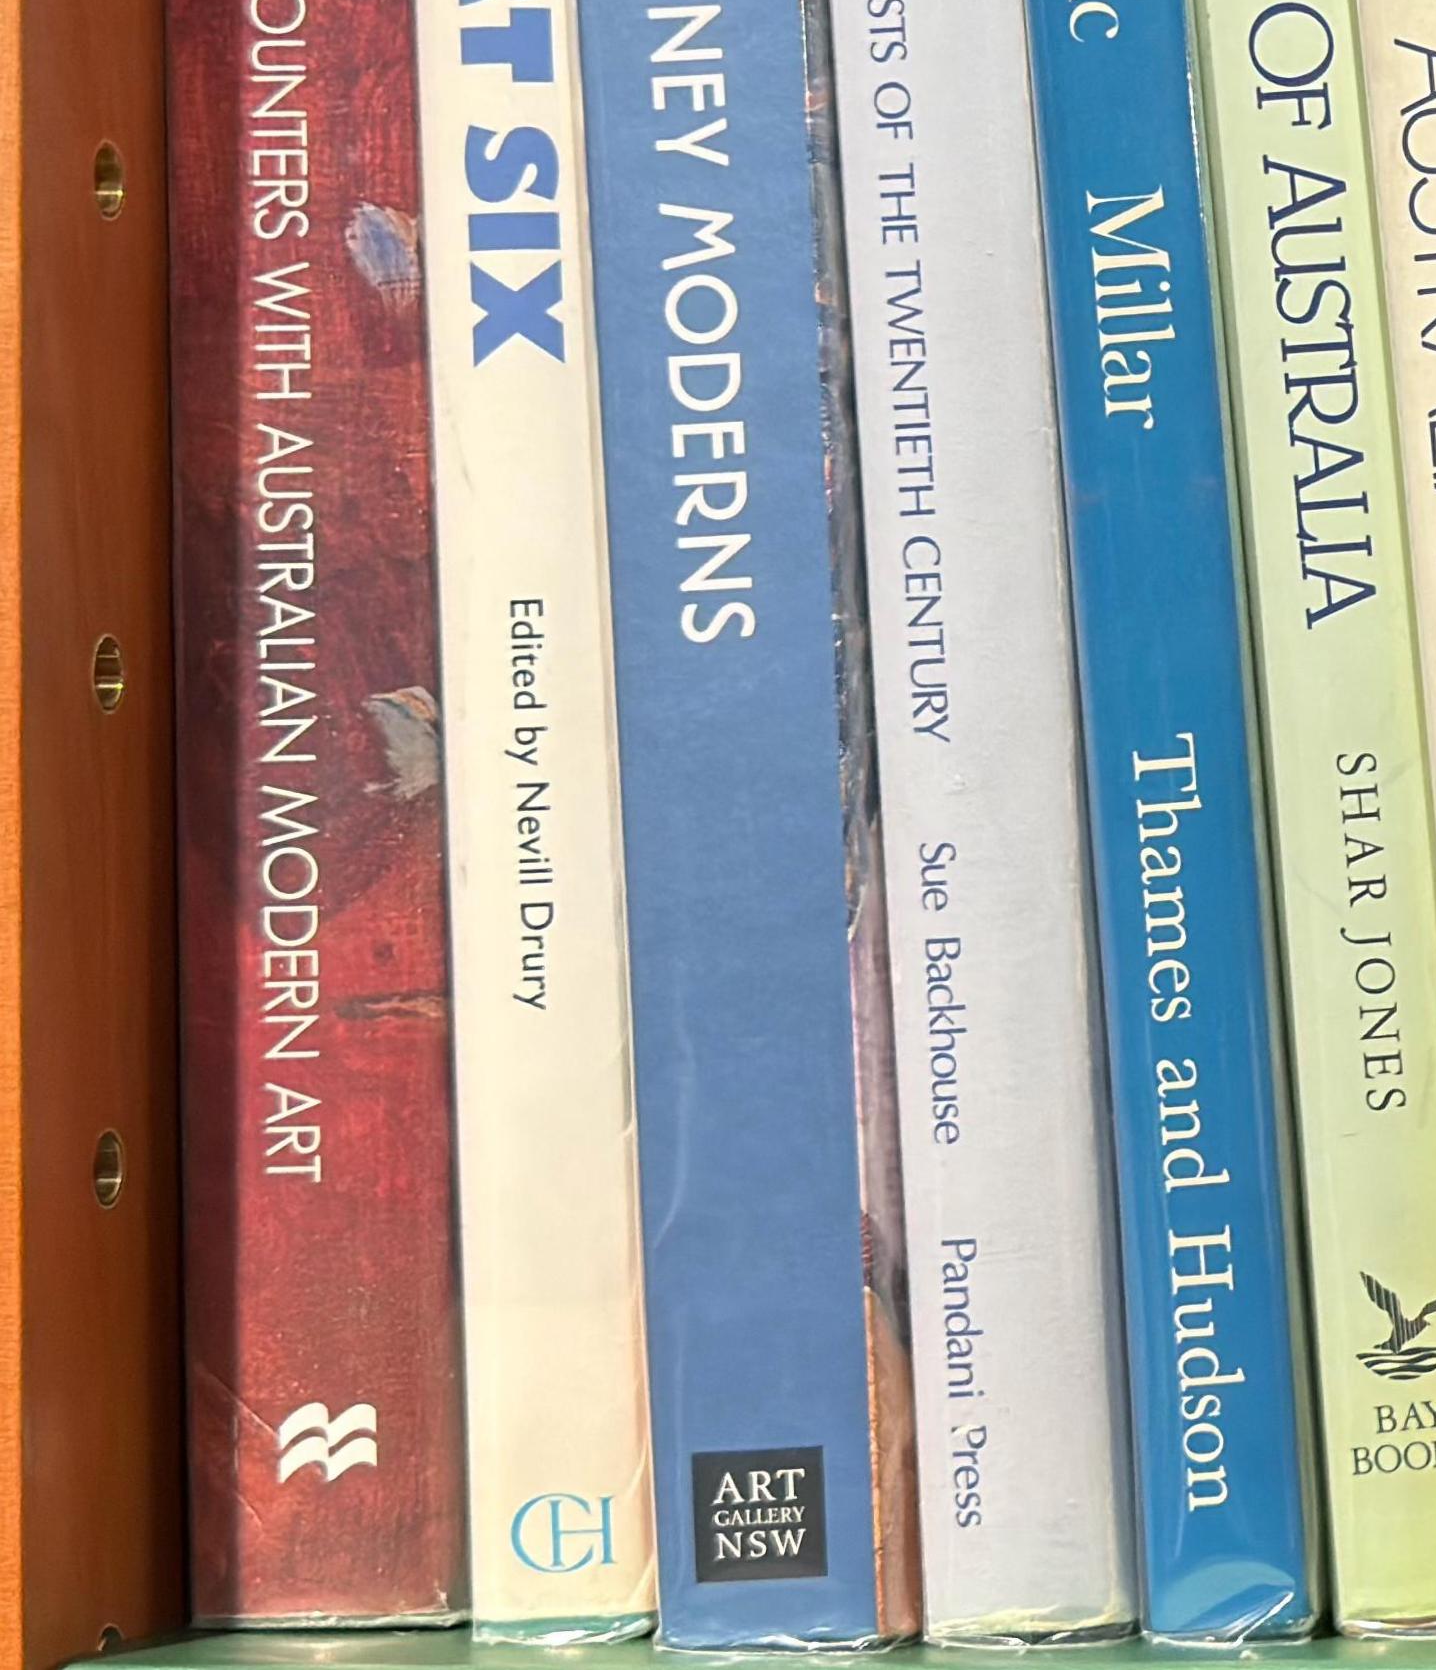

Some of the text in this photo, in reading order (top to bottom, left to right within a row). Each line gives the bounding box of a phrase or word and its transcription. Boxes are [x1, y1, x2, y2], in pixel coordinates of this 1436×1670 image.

[874, 80, 912, 141] OF
[880, 161, 919, 242] THE
[254, 260, 312, 399] WITH
[887, 261, 935, 521] TWENTIETH
[1086, 189, 1175, 430] Millar
[659, 203, 757, 644] MODERNS
[257, 423, 318, 763] AUSTRALIAN
[901, 535, 950, 742] CENTURY
[503, 598, 554, 1012] Edited by Nevill Drury
[258, 785, 322, 1061] MODERN
[919, 842, 960, 1145] Sue Backhouse
[263, 1083, 323, 1183] ART
[712, 1469, 803, 1504] ART
[940, 1236, 983, 1527] Pandani Press
[714, 1503, 805, 1530] GALLERY
[714, 1528, 805, 1560] NSW
